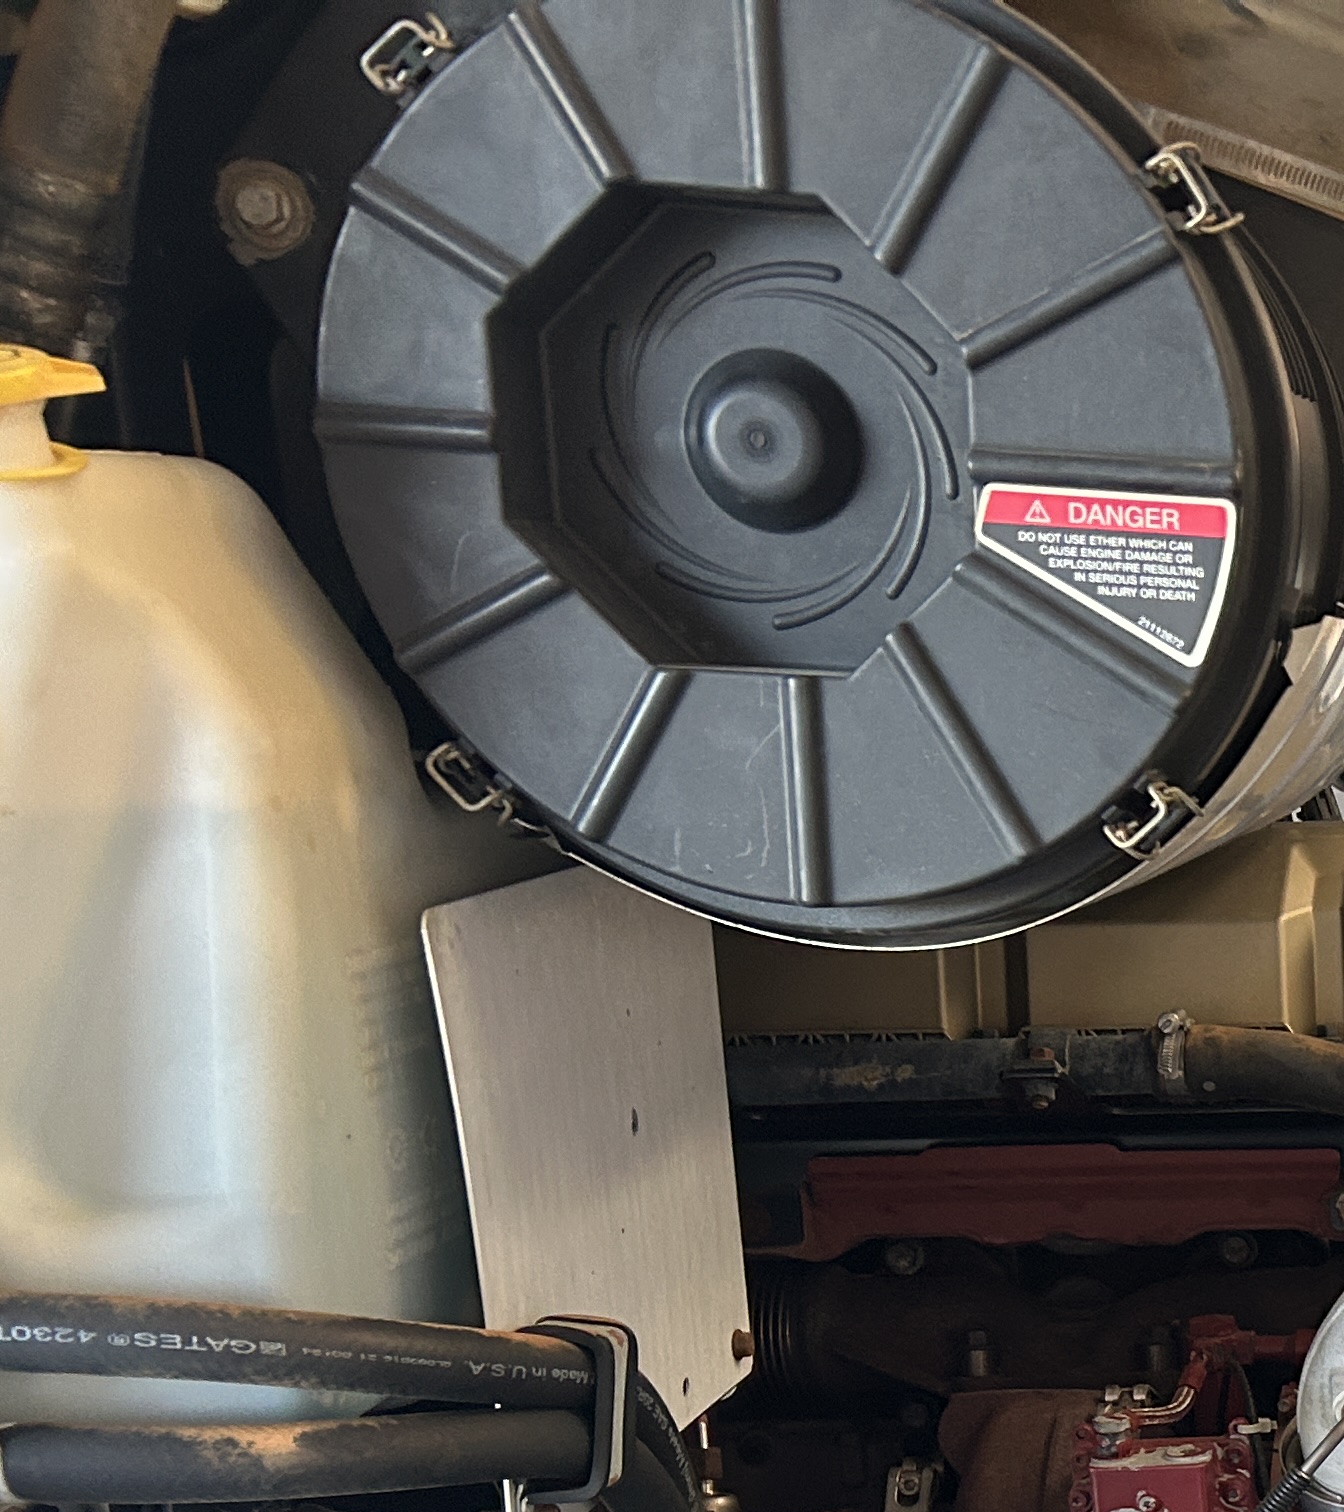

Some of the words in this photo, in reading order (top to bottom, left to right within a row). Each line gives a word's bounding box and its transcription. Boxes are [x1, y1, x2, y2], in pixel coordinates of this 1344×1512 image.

[1068, 501, 1180, 530] DANGER
[1018, 531, 1036, 542] DO
[1038, 532, 1061, 543] NOT
[1064, 533, 1086, 545] USE
[1090, 534, 1125, 547] ETHER
[1129, 537, 1166, 550] WHICH
[1170, 541, 1192, 552] CAN
[1040, 545, 1078, 557] CAUSE
[1080, 547, 1123, 559] ENGINE
[1126, 549, 1173, 562] DAMAGE
[1176, 553, 1192, 563] OR
[1048, 558, 1140, 572] EXPLOSION/FIRE
[1143, 564, 1204, 578] RESULTING
[1075, 573, 1085, 581] IN
[1089, 574, 1137, 585] SERIOUS
[1140, 576, 1199, 590] PERSONAL
[1098, 586, 1137, 598] INJURY
[1140, 588, 1157, 598] OR
[1160, 589, 1195, 601] DEATH
[464, 1360, 526, 1382] U.S.A.
[532, 1364, 547, 1381] in
[550, 1366, 589, 1385] Made
